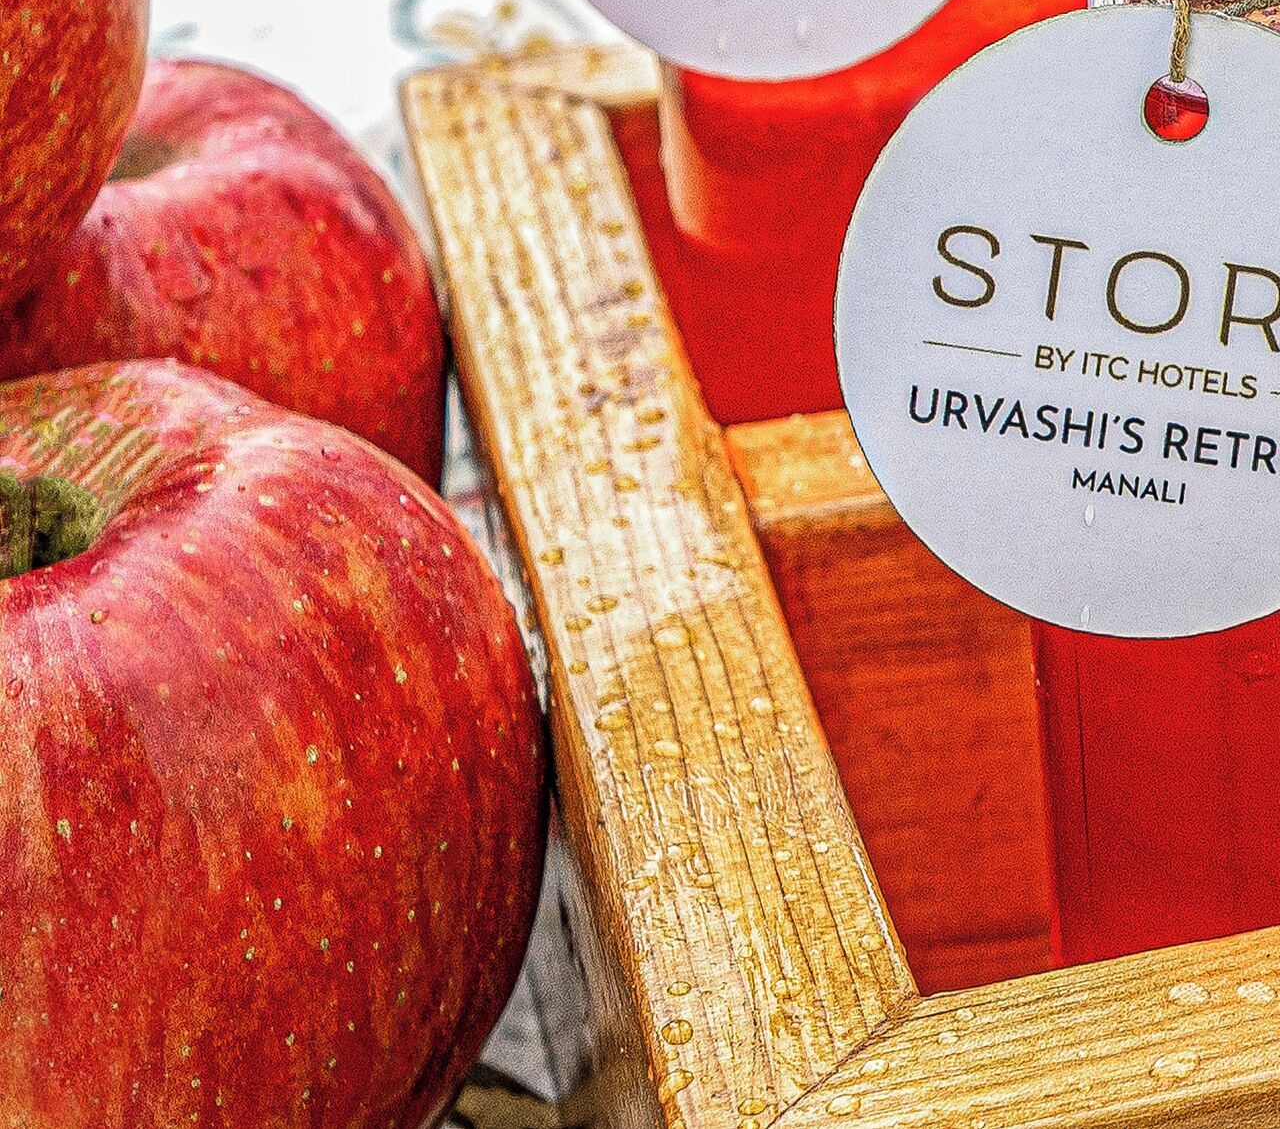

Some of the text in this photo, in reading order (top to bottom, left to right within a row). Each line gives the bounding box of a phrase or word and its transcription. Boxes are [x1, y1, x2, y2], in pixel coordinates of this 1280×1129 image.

[1034, 345, 1258, 400] BY ITC HOTELS
[908, 385, 1145, 454] URVASHI'S
[1071, 468, 1187, 505] MANALI
